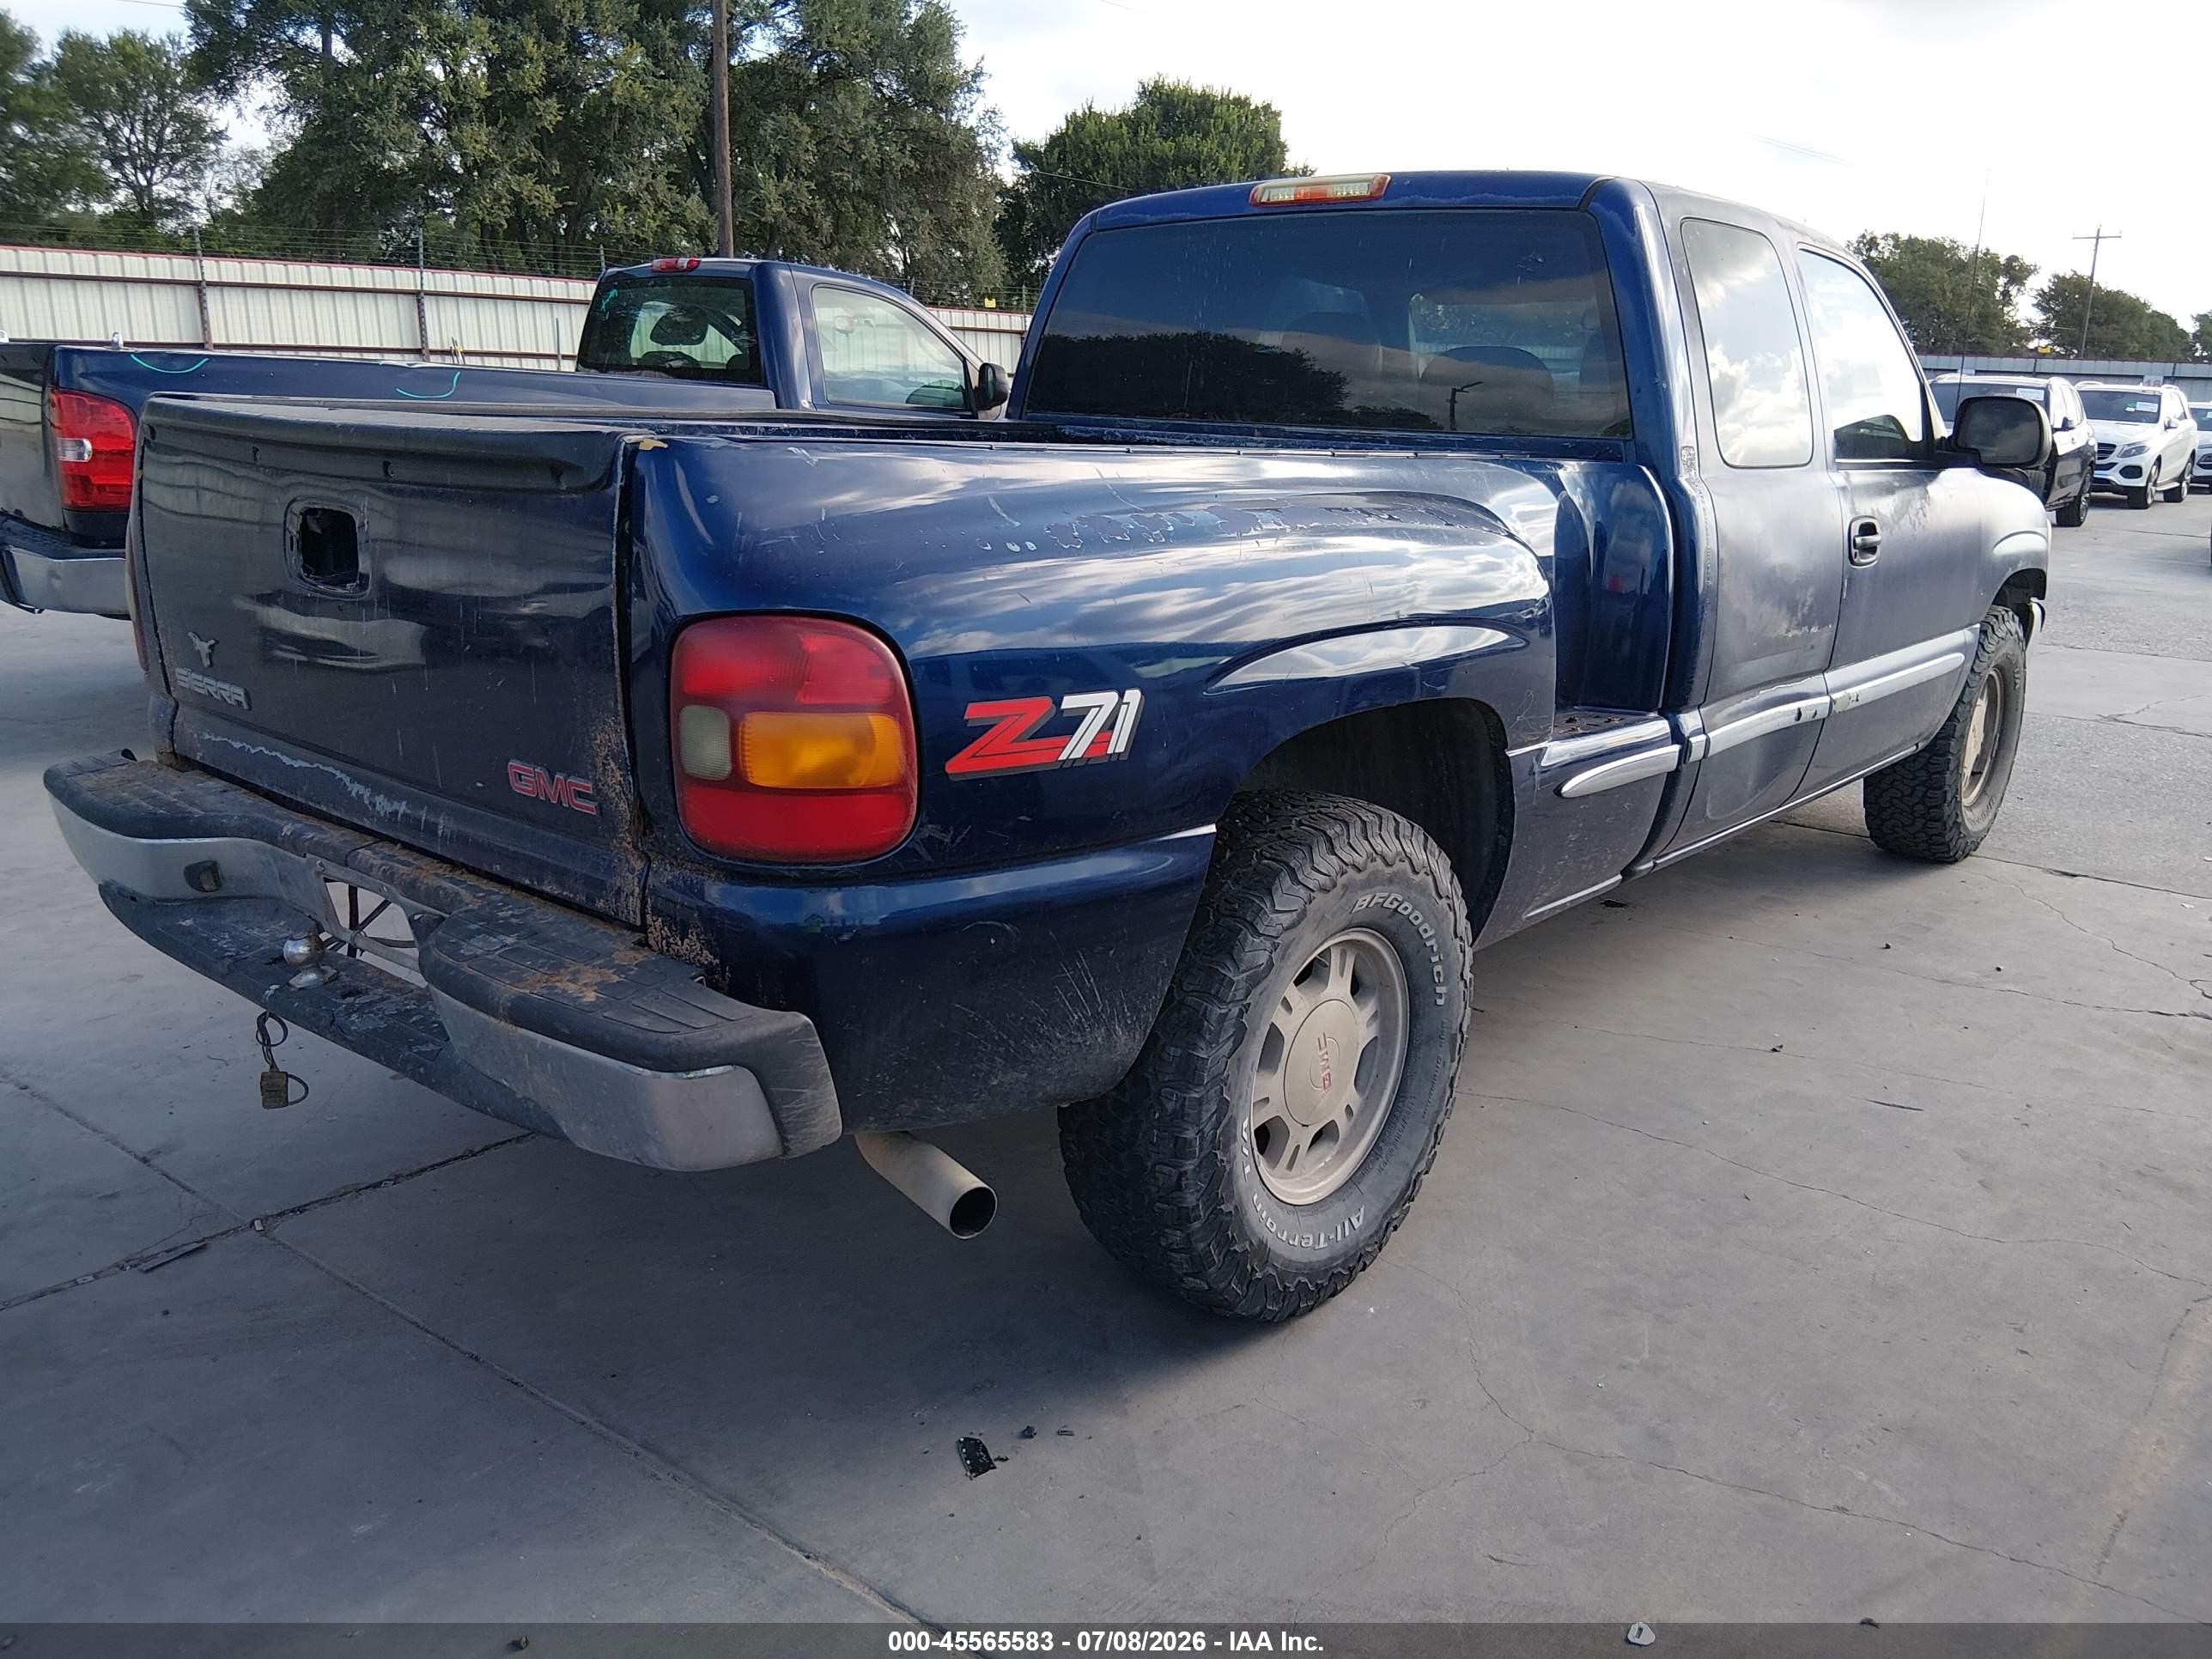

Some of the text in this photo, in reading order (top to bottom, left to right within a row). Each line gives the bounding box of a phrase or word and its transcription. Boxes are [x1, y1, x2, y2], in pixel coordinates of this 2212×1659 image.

[176, 667, 249, 710] SIERRA
[945, 688, 1145, 781] Z71
[507, 760, 598, 815] GMC
[1351, 892, 1448, 1006] BFGoodrich
